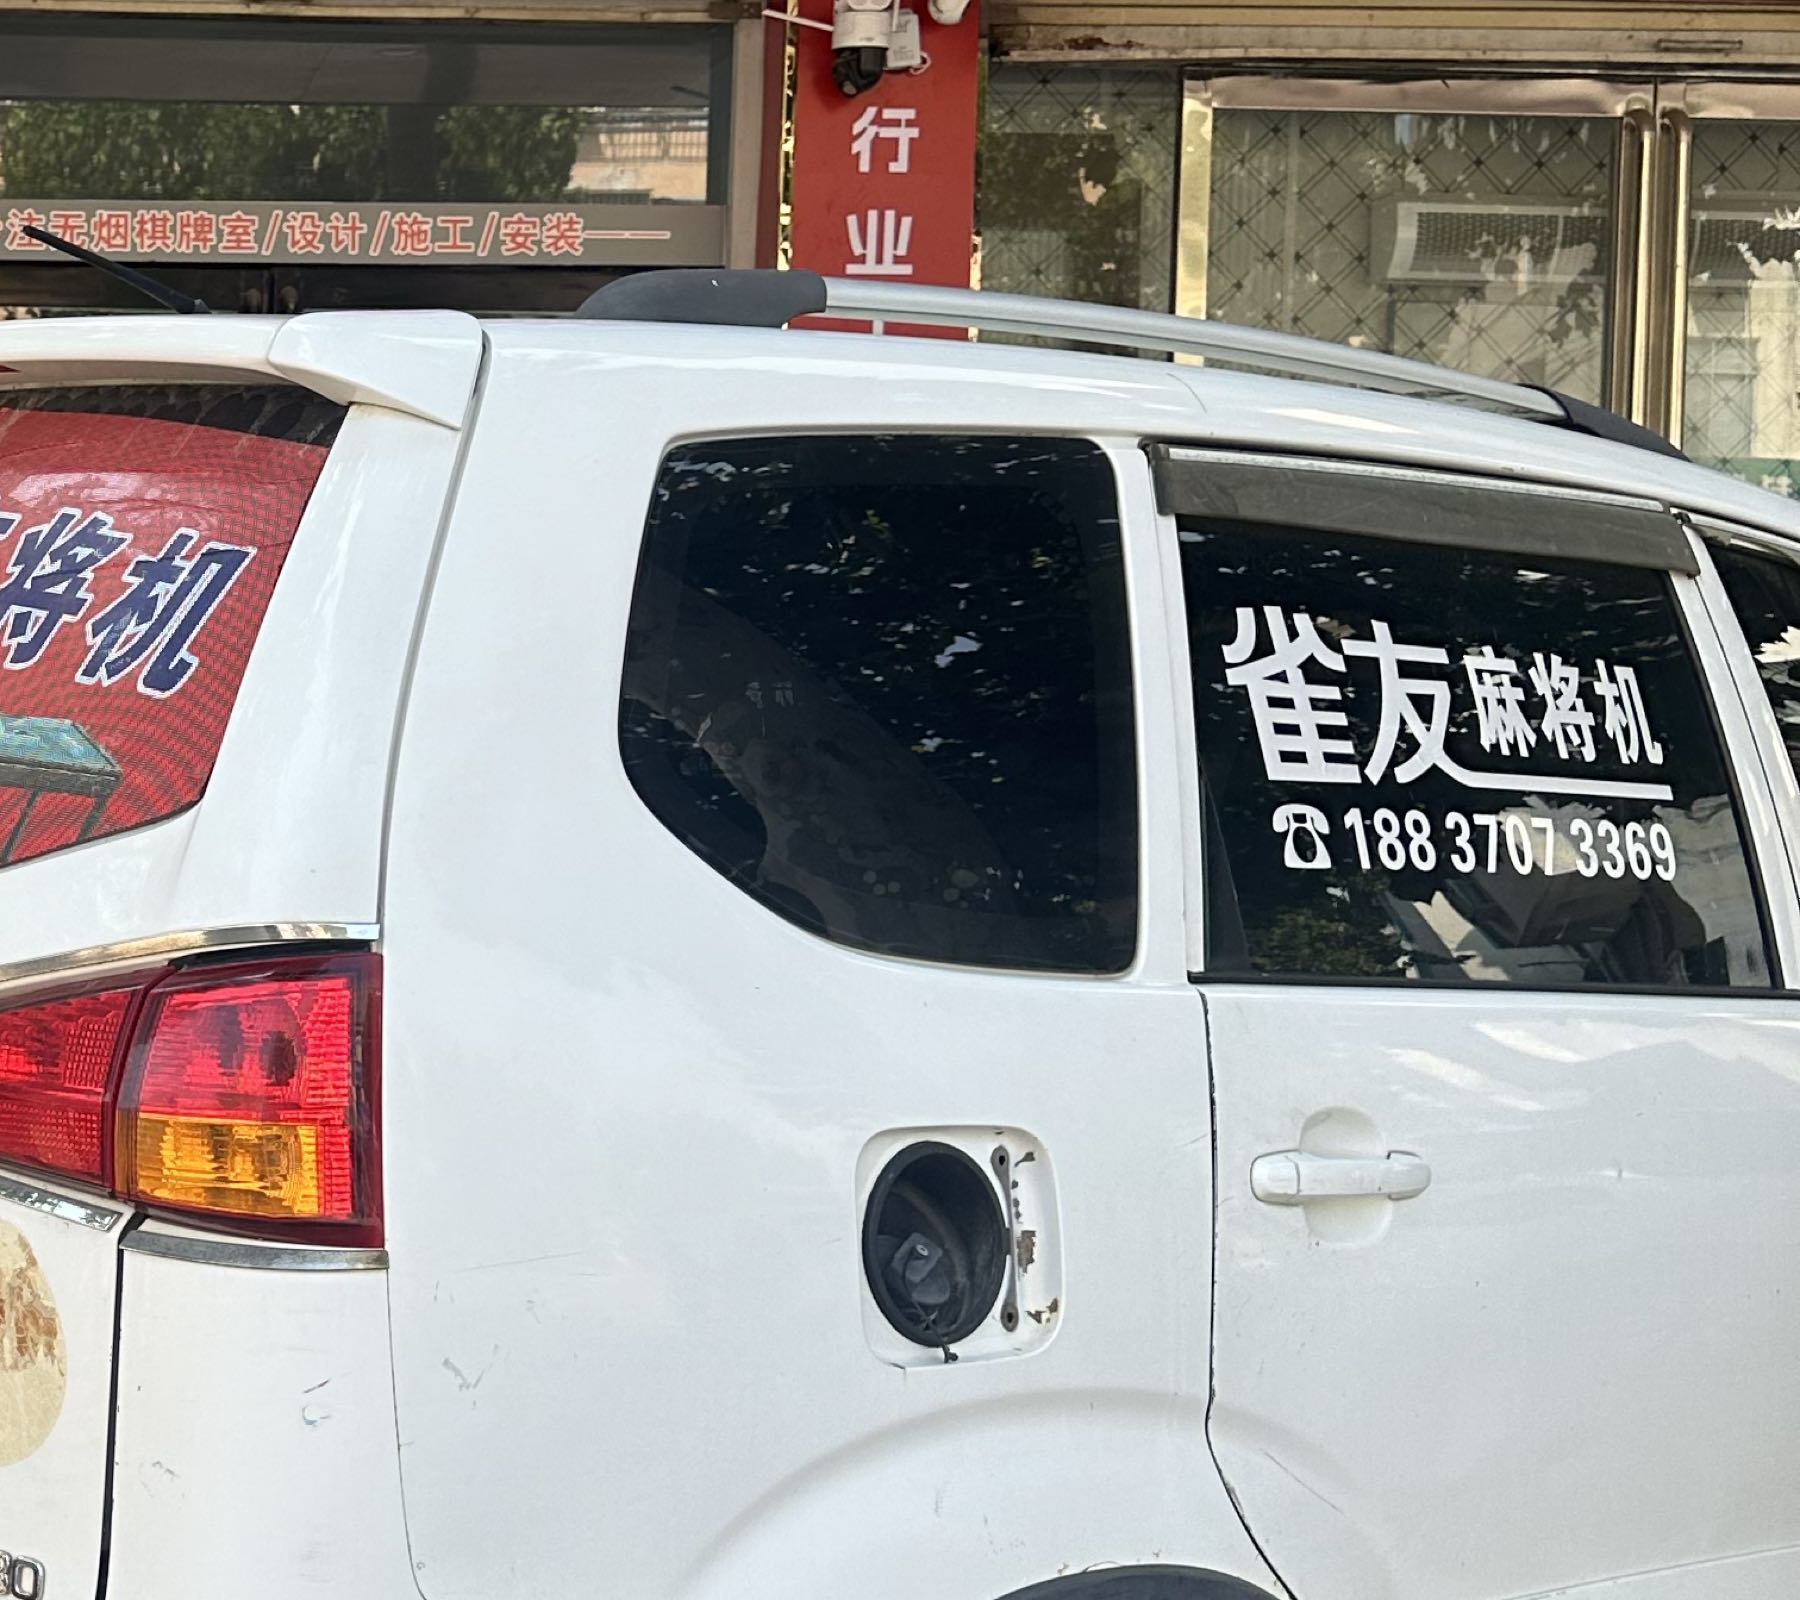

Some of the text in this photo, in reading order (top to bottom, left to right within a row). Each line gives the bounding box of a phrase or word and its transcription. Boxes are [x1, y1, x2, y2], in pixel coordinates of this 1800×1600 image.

[1220, 605, 1664, 786] 雀友 麻将机
[1343, 807, 1678, 882] 188 3707 3369
